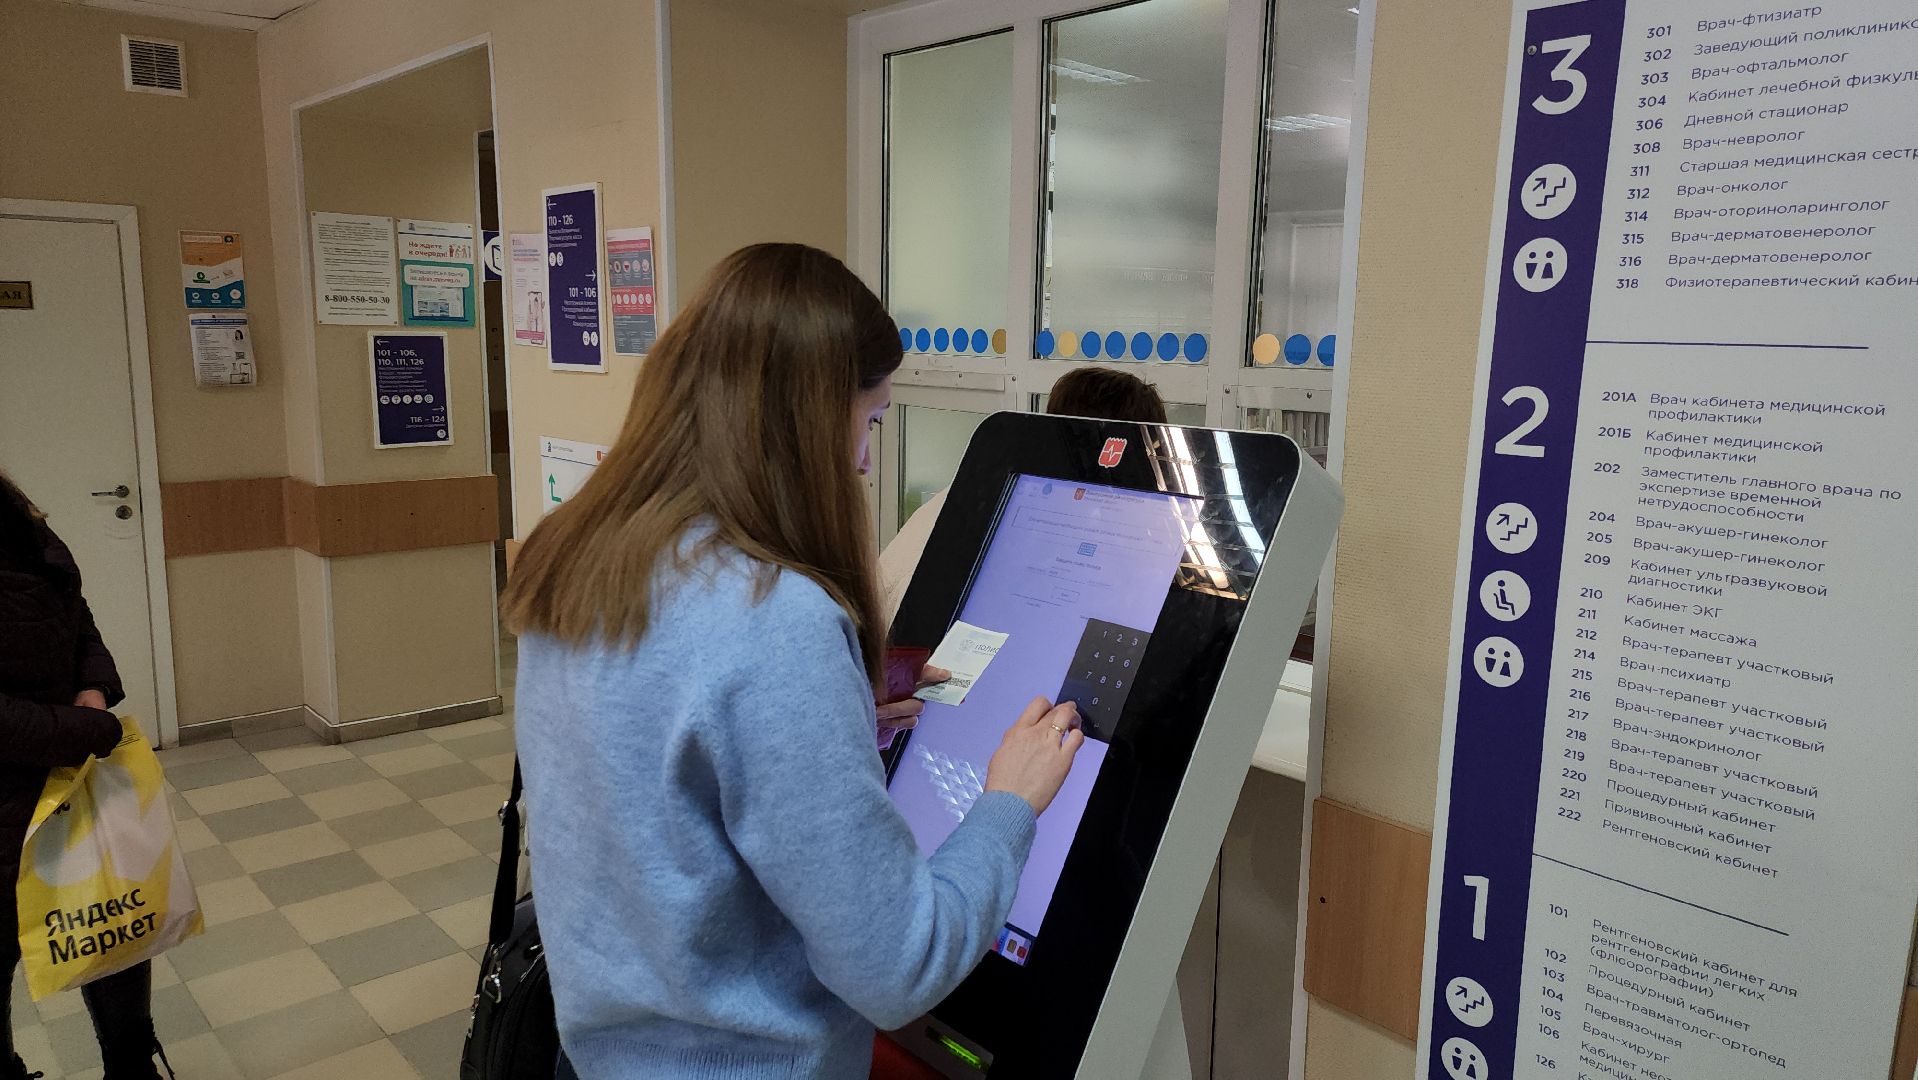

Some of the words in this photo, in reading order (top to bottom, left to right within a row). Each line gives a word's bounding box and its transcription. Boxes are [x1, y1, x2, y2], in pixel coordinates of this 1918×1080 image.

[1646, 24, 1672, 39] 301
[1697, 6, 1823, 33] Врач-фтизиатр
[1642, 48, 1672, 63] 302
[1693, 33, 1798, 56] Заведующий
[1531, 34, 1592, 115] 3
[1640, 71, 1670, 86] 303
[1691, 52, 1850, 81] Врач-офтальмолог
[1637, 94, 1667, 109] 304
[1688, 87, 1755, 103] Кабинет
[1757, 75, 1841, 96] лечебной
[1635, 117, 1664, 132] 306
[1683, 108, 1754, 129] Дневной
[1758, 102, 1849, 120] стационар
[1632, 141, 1661, 155] 308
[1682, 130, 1806, 152] Врач-невролог
[1629, 164, 1650, 177] 311
[1679, 159, 1749, 174] Старшая
[1753, 151, 1867, 169] медицинская
[1626, 187, 1650, 200] 312
[1676, 180, 1789, 198] Врач-онколог
[548, 215, 558, 227] 110
[562, 214, 574, 226] 126
[1624, 210, 1649, 223] 314
[1673, 200, 1891, 221] Врач-оториноларинголог
[1621, 233, 1645, 245] 315
[1671, 226, 1877, 244] Врач-дерматовенеролог
[1618, 255, 1642, 267] 316
[1668, 251, 1873, 268] Врач-дерматовенеролог
[568, 287, 579, 298] 101
[584, 287, 597, 298] 106
[1615, 278, 1639, 290] 318
[1665, 273, 1860, 290] Физиотерапевтический
[377, 349, 391, 357] 101
[410, 358, 425, 366] 126
[431, 415, 446, 423] 124
[1601, 391, 1637, 403] 201А
[1650, 393, 1687, 407] Врач
[1691, 396, 1765, 410] кабинета
[1769, 400, 1886, 417] медицинской
[1648, 409, 1762, 425] профилактики
[1494, 385, 1550, 458] 2
[1597, 426, 1632, 439] 201Б
[1646, 429, 1709, 445] Кабинет
[1713, 436, 1824, 453] медицинской
[1644, 446, 1757, 464] профилактики
[1593, 461, 1621, 474] 202
[1640, 466, 1737, 485] Заместитель
[1741, 477, 1817, 493] главного
[1822, 484, 1873, 498] врача
[1879, 489, 1902, 501] по
[1639, 482, 1726, 499] экспертизе
[1730, 491, 1822, 509] временной
[1637, 496, 1805, 523] нетрудоспособности
[1588, 510, 1616, 524] 204
[1635, 515, 1830, 549] Врач-акушер-гинеколог
[1586, 531, 1613, 544] 205
[1633, 537, 1826, 573] Врач-акушер-гинеколог
[1583, 552, 1611, 566] 209
[1630, 558, 1693, 577] Кабинет
[1696, 570, 1828, 597] ультразвуковой
[1627, 574, 1723, 597] диагностики
[1579, 587, 1603, 600] 210
[1626, 593, 1689, 613] Кабинет
[1692, 604, 1724, 619] ЭКГ
[1103, 630, 1108, 638] 1
[1116, 633, 1123, 643] 2
[1131, 638, 1139, 646] 3
[1577, 607, 1597, 620] 211
[1624, 614, 1686, 635] Кабинет
[1689, 628, 1757, 649] массажа
[1094, 651, 1100, 659] 4
[1108, 655, 1116, 663] 5
[1123, 659, 1131, 668] 6
[1573, 647, 1596, 662] 214
[1619, 656, 1731, 689] Врач-психиатр
[1575, 627, 1598, 641] 212
[1622, 635, 1733, 666] Врач-терапевт
[1736, 658, 1834, 685] участковый
[1086, 671, 1093, 679] 7
[1099, 675, 1107, 684] 8
[1115, 680, 1122, 689] 9
[1091, 697, 1099, 705] 0
[1570, 668, 1593, 681] 215
[1617, 676, 1728, 709] Врач-терапевт
[1730, 703, 1828, 731] участковый
[1567, 708, 1590, 721] 217
[1613, 717, 1763, 762] Врач-эндокринолог
[1568, 688, 1591, 702] 216
[1615, 697, 1725, 731] Врач-терапевт
[1728, 725, 1825, 753] участковый
[1565, 727, 1587, 742] 218
[1611, 738, 1720, 774] Врач-терапевт
[1722, 767, 1818, 799] участковый
[1561, 767, 1587, 783] 220
[1606, 778, 1708, 815] Процедурный
[1711, 808, 1777, 833] кабинет
[1563, 748, 1586, 762] 219
[1609, 758, 1718, 796] Врач-терапевт
[1720, 789, 1815, 821] участковый
[1559, 786, 1581, 802] 221
[1604, 798, 1704, 836] Прививочный
[1708, 830, 1773, 854] кабинет
[1557, 806, 1582, 822] 222
[1602, 818, 1710, 859] Рентгеновский
[1715, 853, 1779, 879] кабинет
[45, 888, 146, 937] Яндекс
[1463, 874, 1490, 942] 1
[47, 912, 158, 966] Маркет
[1548, 903, 1568, 919] 101
[1593, 918, 1698, 964] Рентгеновский
[1702, 958, 1766, 987] кабинет
[1767, 981, 1798, 998] для
[1591, 933, 1709, 980] рентгенографии
[1712, 977, 1766, 1002] легких
[1544, 947, 1567, 964] 102
[1589, 964, 1686, 1009] Процедурный
[1689, 1003, 1751, 1032] кабинет
[1540, 1004, 1562, 1021] 105
[1582, 1021, 1671, 1064] Врач-хирург
[1541, 985, 1564, 1003] 104
[1584, 1002, 1683, 1049] Перевязочная
[1542, 966, 1566, 983] 103
[1586, 983, 1786, 1070] Врач-травматолог-ортопед
[1535, 1053, 1556, 1070] 126
[1538, 1022, 1560, 1040] 106
[1581, 1040, 1638, 1072] Кабинет
